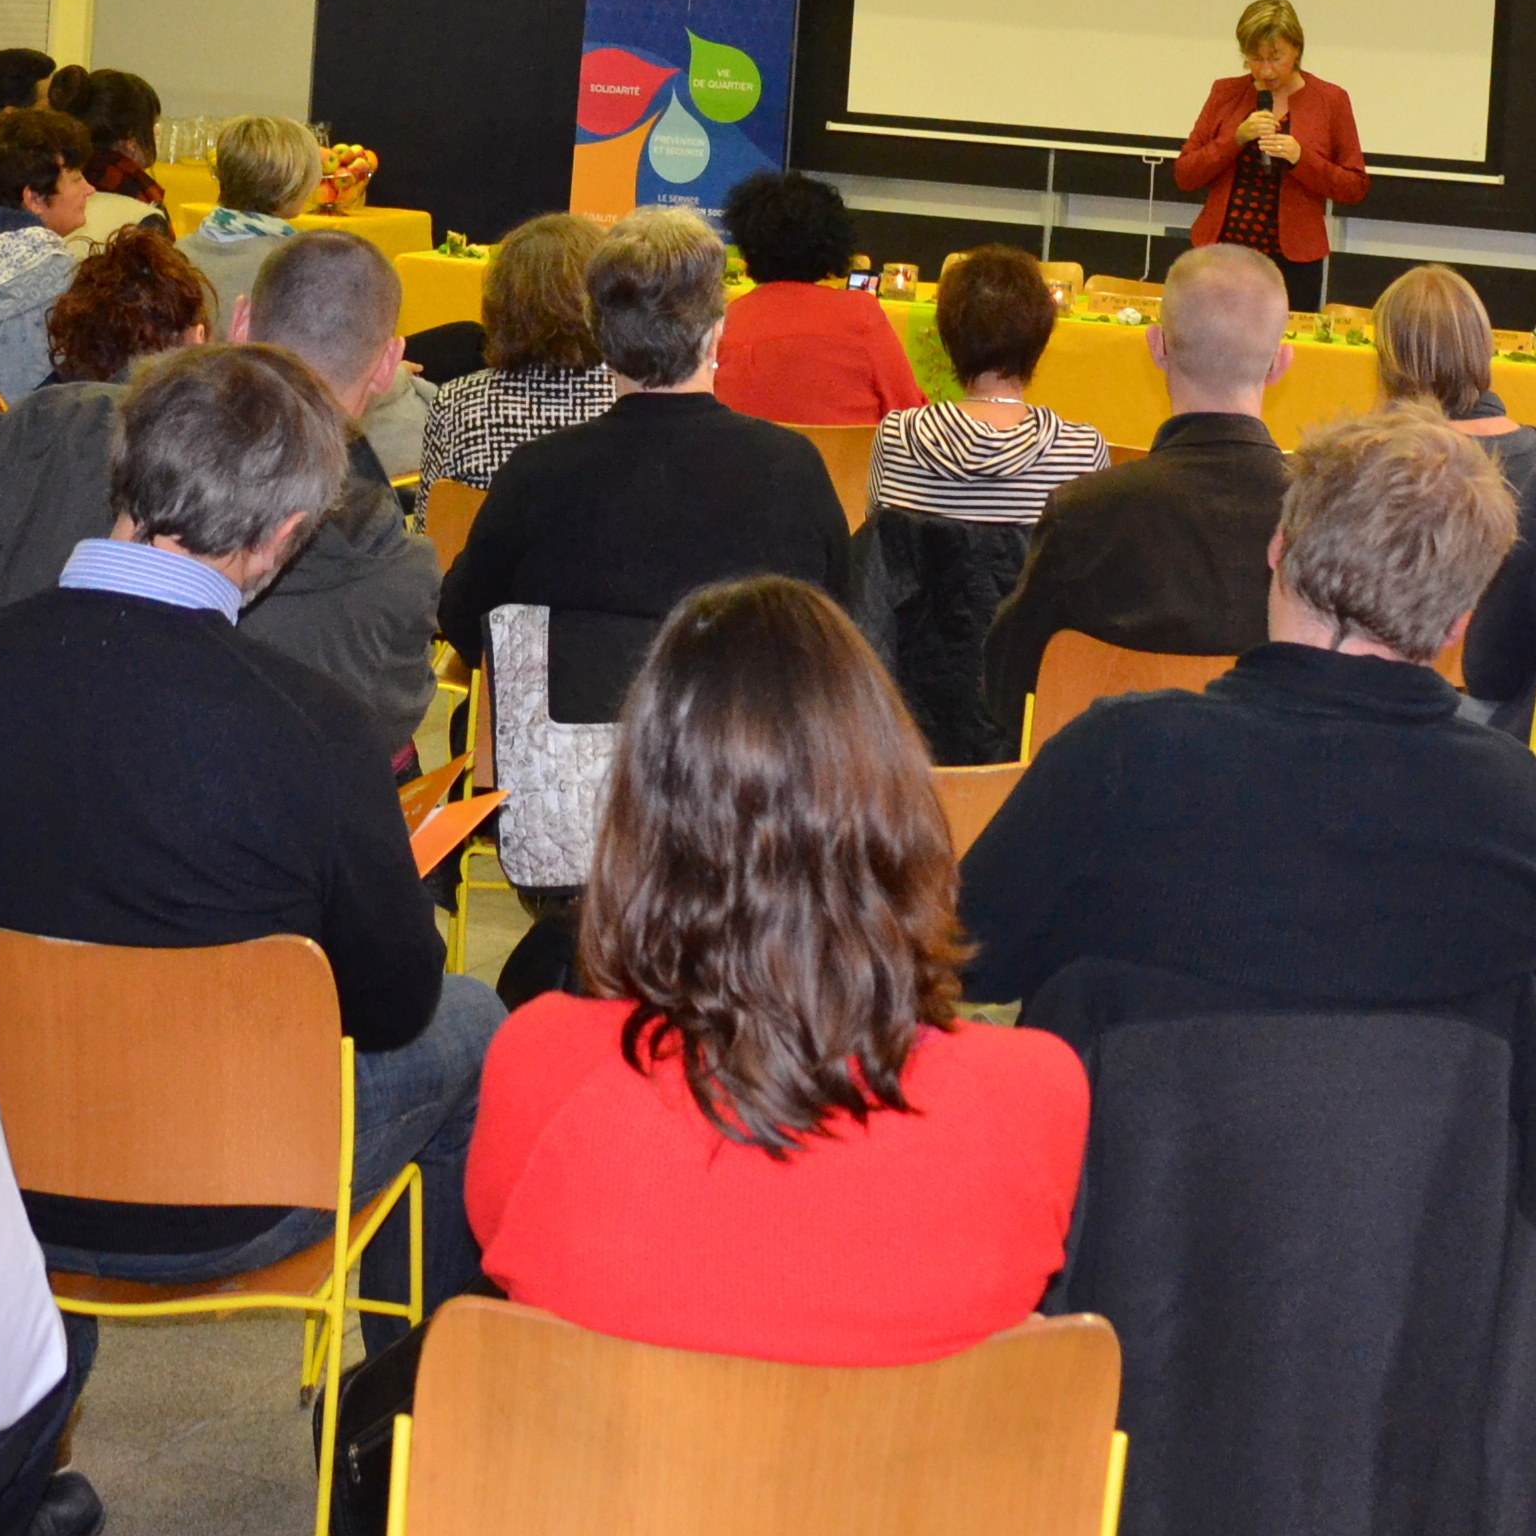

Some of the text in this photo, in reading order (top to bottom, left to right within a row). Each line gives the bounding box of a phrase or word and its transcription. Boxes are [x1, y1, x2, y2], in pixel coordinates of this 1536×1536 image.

[717, 68, 731, 77] VIE
[590, 83, 641, 96] SOLIDARITÉ
[693, 79, 754, 91] DE QUARTIER
[657, 194, 700, 205] LE SERVICE
